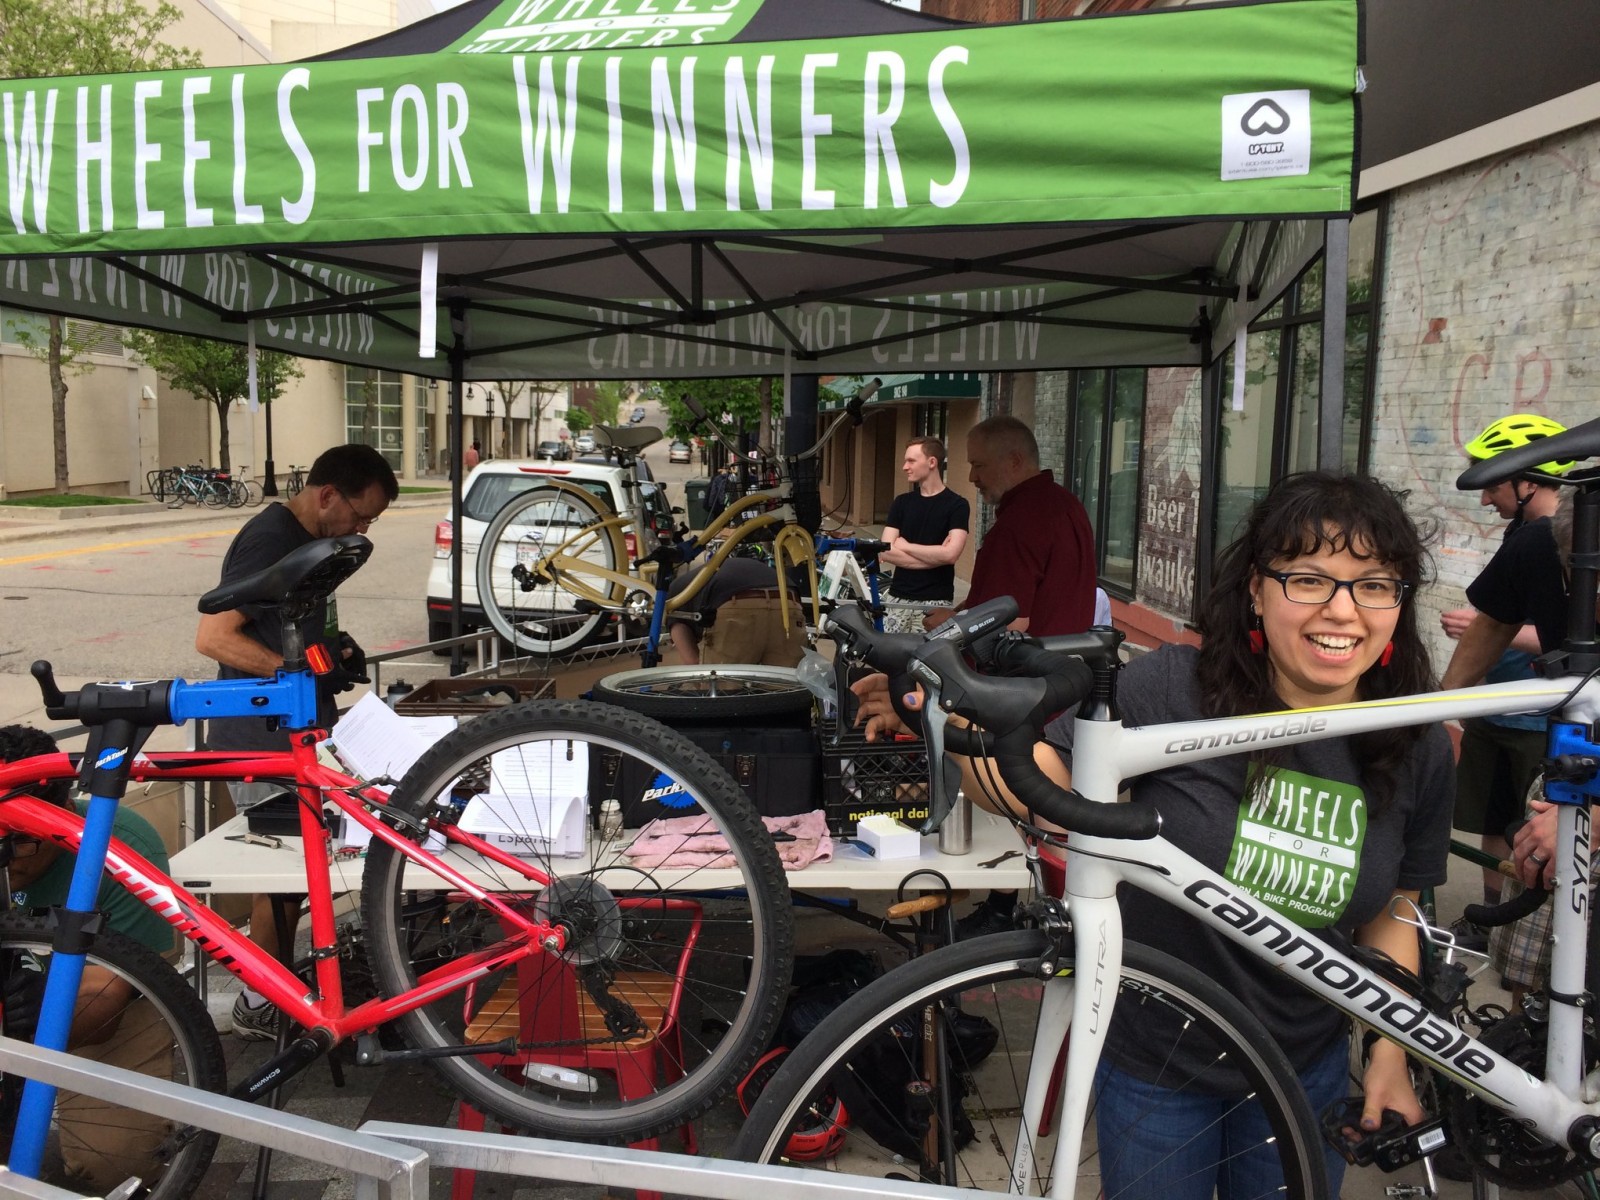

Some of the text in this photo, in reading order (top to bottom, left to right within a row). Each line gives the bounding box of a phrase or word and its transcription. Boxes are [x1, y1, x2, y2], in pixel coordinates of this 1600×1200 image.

[540, 16, 670, 33] FOR
[3, 45, 970, 235] WHEELS FOR WINNERS
[1146, 484, 1186, 533] Beer
[1164, 716, 1328, 755] cannondale
[1248, 776, 1362, 846] WHEELS
[1268, 831, 1329, 858] FOR
[1233, 842, 1351, 908] WINNERS
[1253, 891, 1260, 899] A
[1263, 893, 1286, 906] BIKE
[1288, 900, 1336, 919] PROGRAM
[1183, 878, 1496, 1079] cannondale
[249, 1068, 281, 1092] SCHWINN
